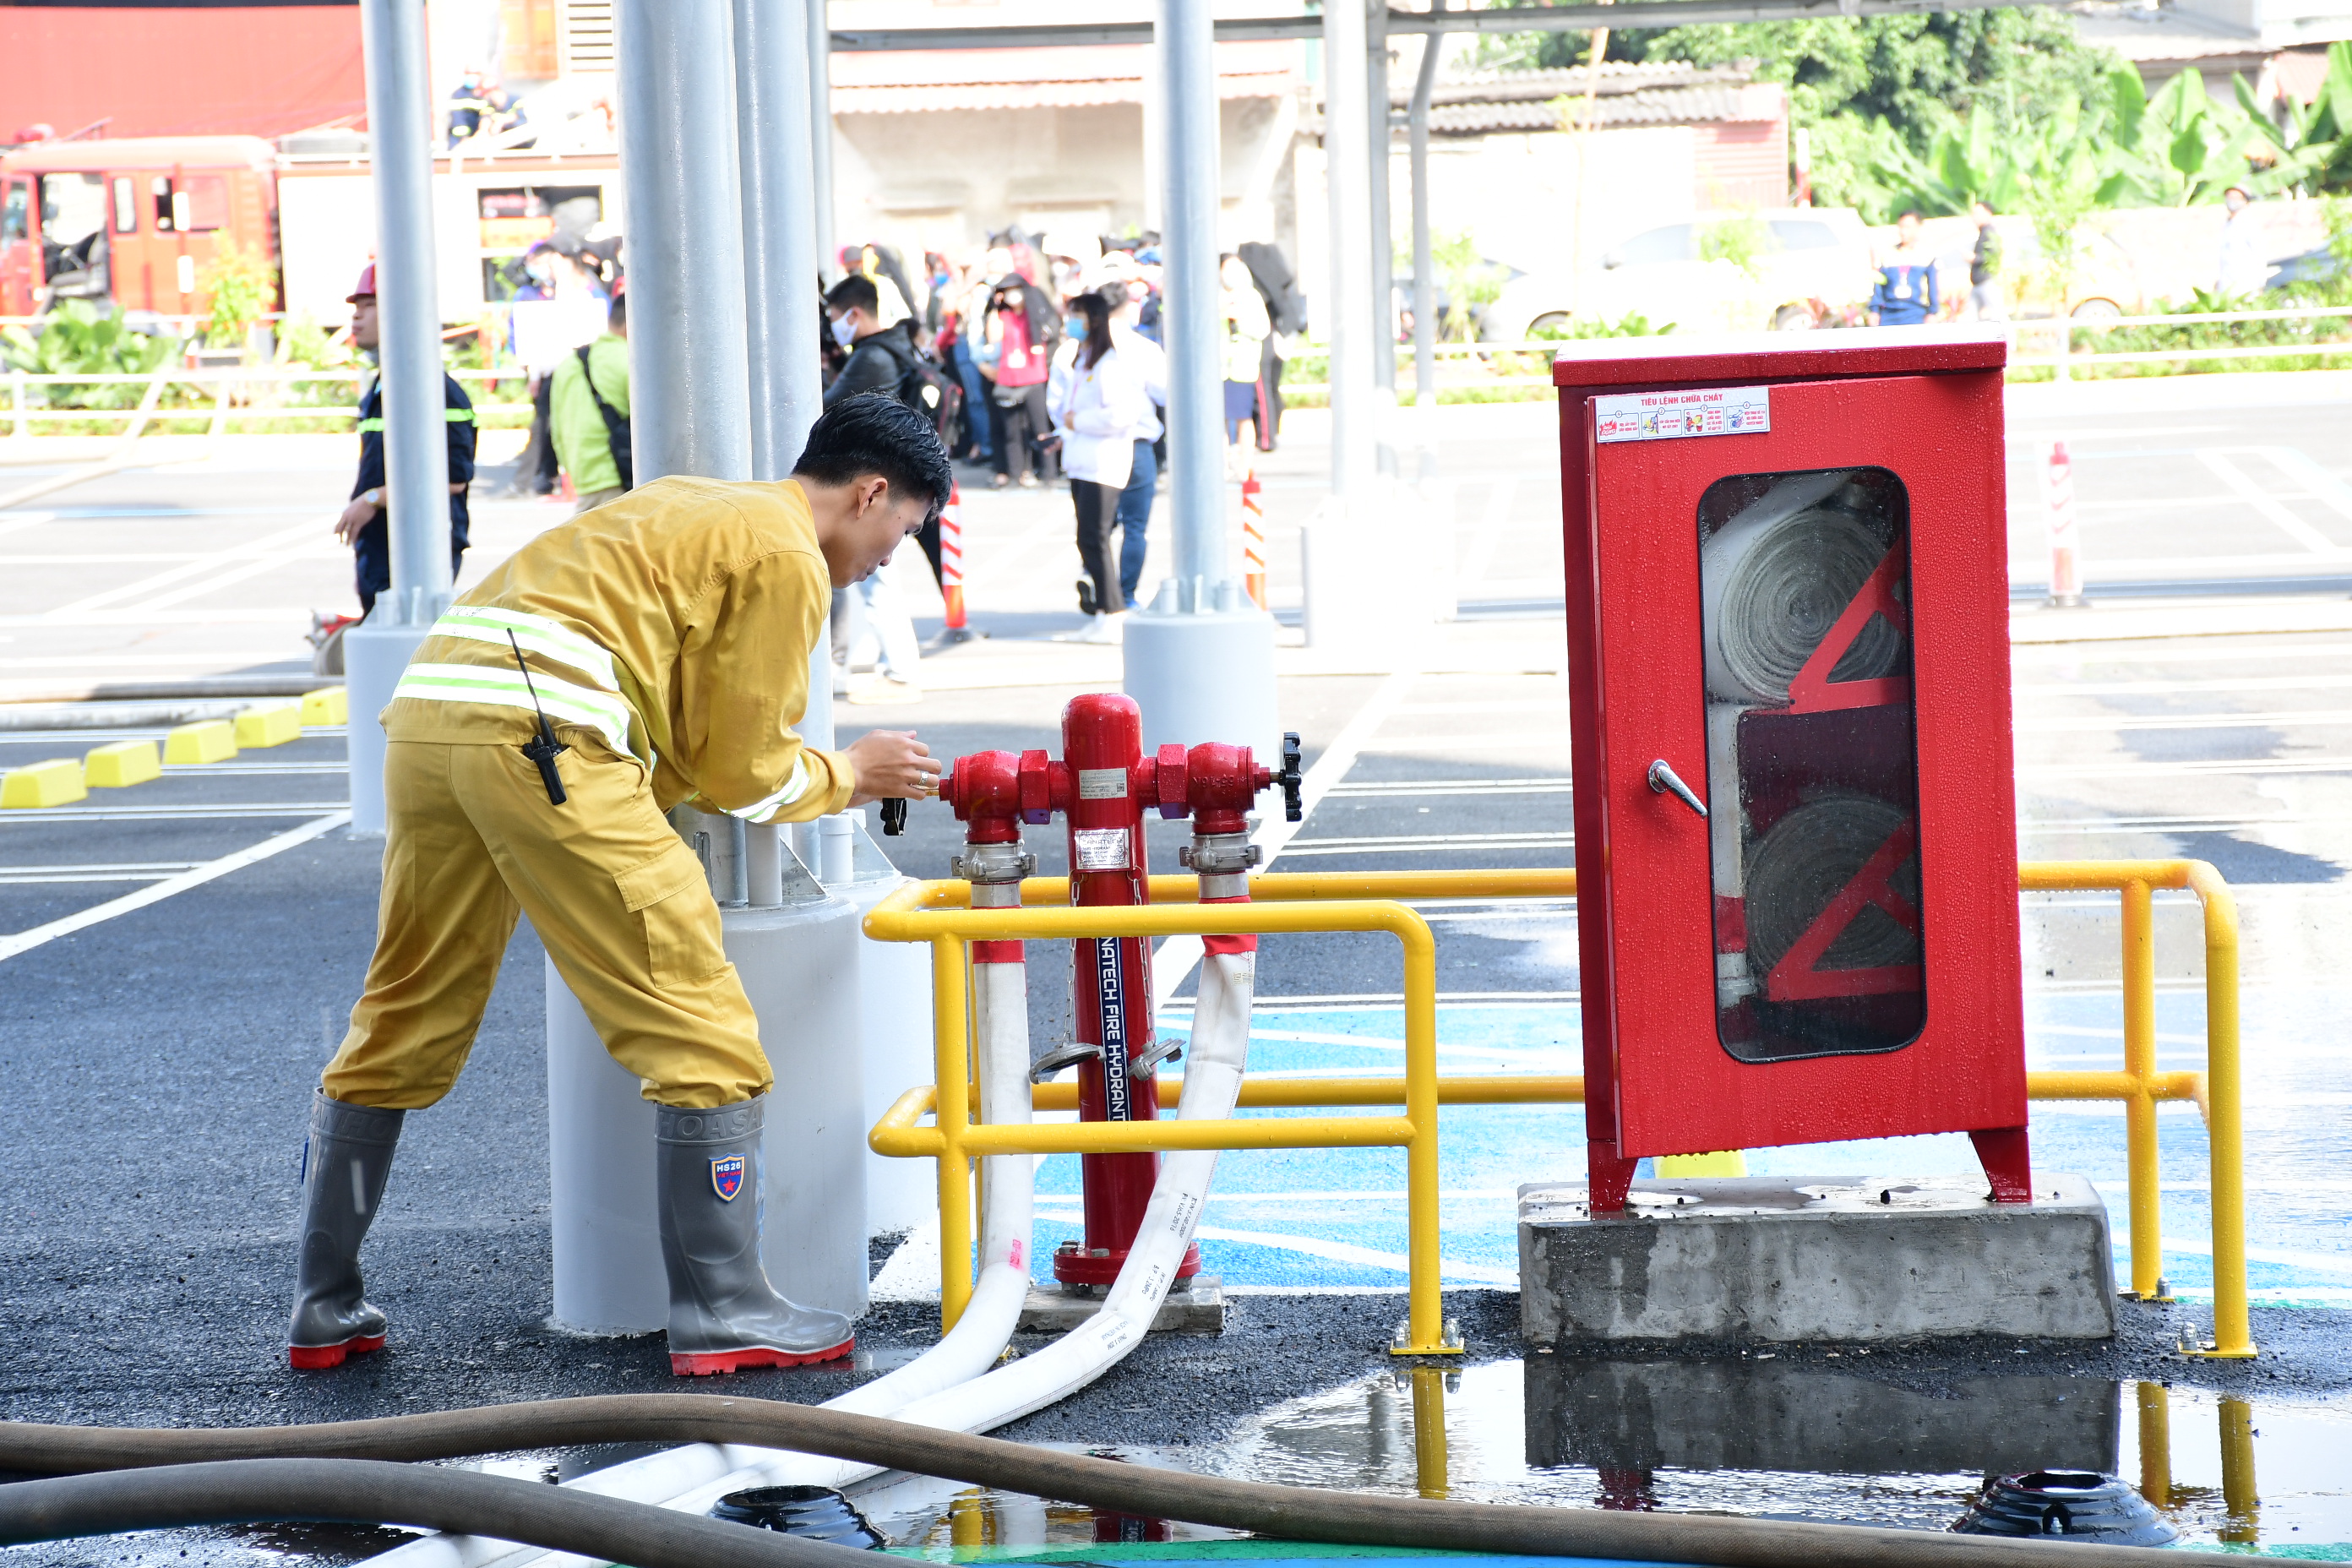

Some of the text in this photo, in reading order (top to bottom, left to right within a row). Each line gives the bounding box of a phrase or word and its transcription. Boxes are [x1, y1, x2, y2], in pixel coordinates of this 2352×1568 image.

[1641, 393, 1723, 406] TIÊU LỆNH CHỮA CHÁY
[1105, 1004, 1121, 1041] FIRE
[1108, 1044, 1126, 1121] HYDRANT
[716, 1162, 741, 1173] HS26
